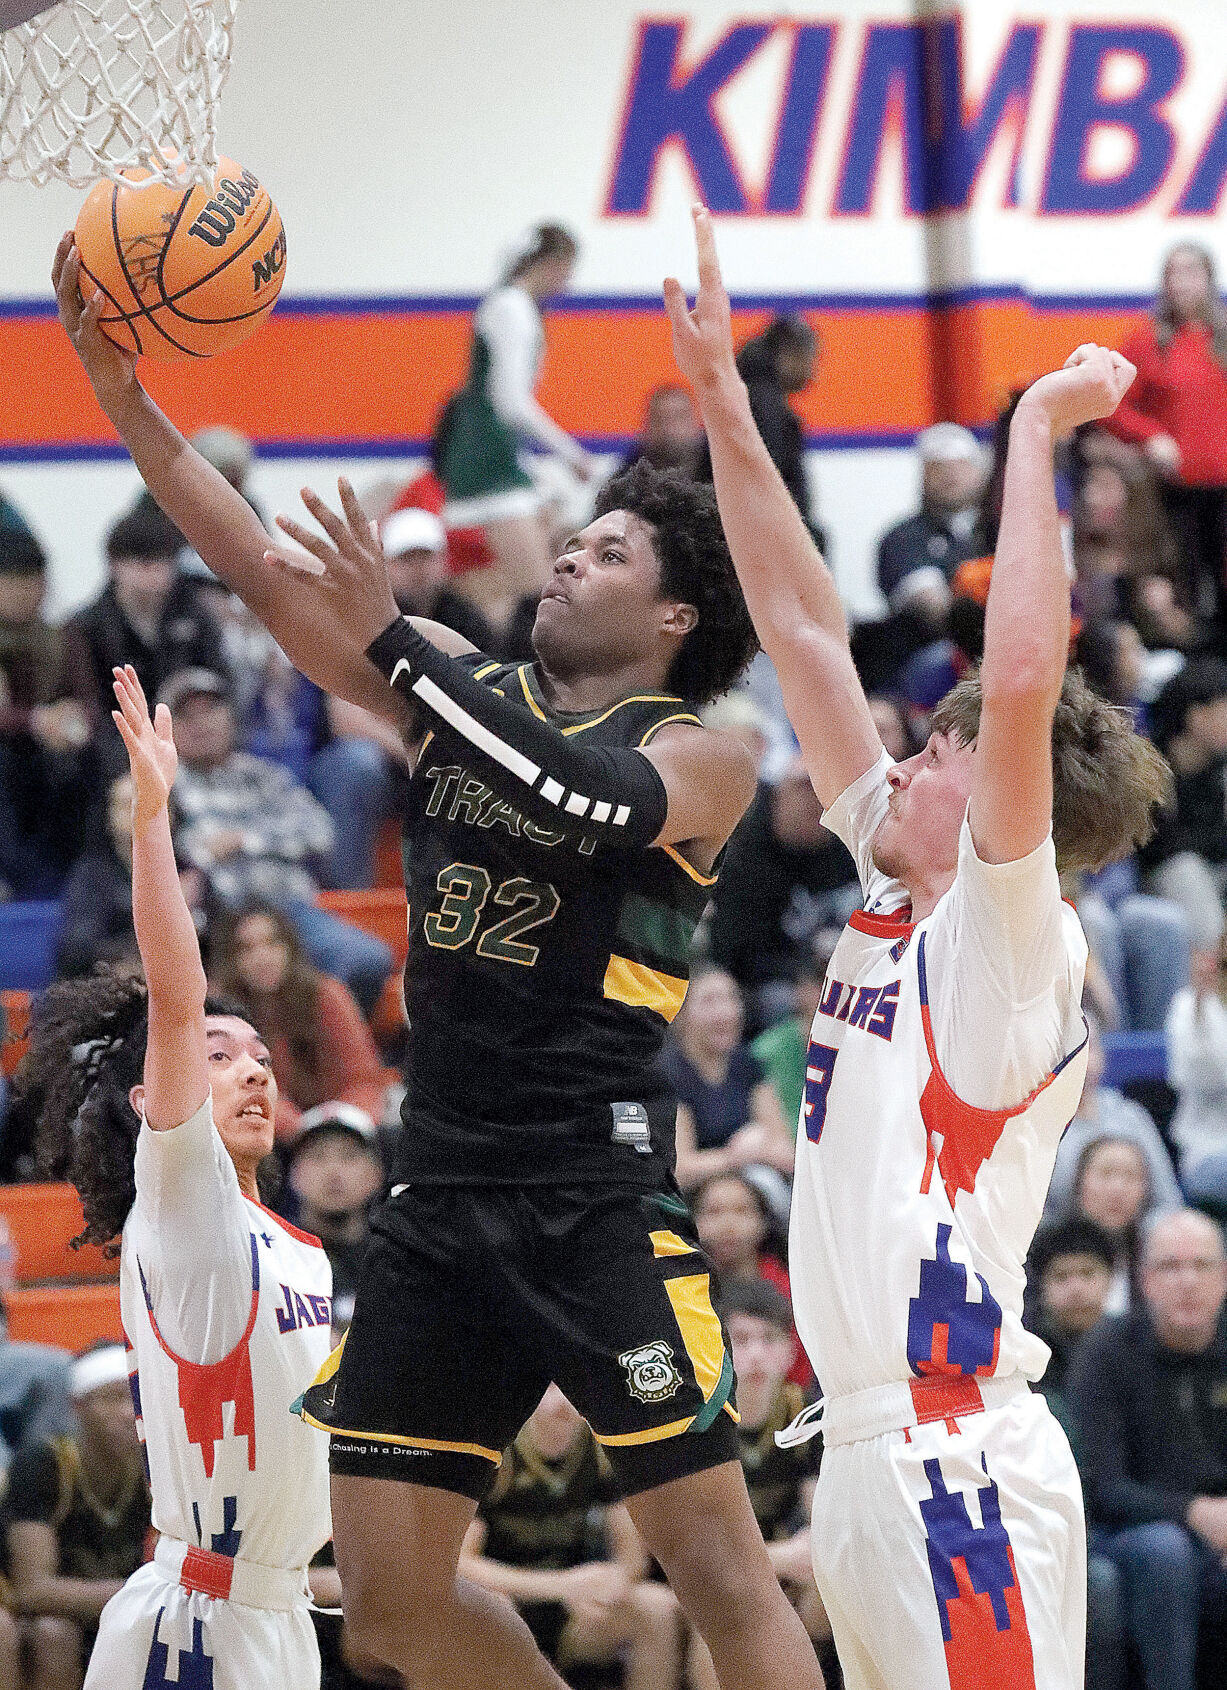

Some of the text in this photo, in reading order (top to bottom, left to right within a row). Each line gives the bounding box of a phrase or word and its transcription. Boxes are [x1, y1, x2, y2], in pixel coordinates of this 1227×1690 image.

[252, 231, 287, 292] NC
[426, 765, 597, 856] TRA
[424, 862, 561, 967] 32
[275, 1282, 332, 1334] JAG
[332, 1443, 367, 1454] Chasing
[393, 1447, 433, 1457] Dream.
